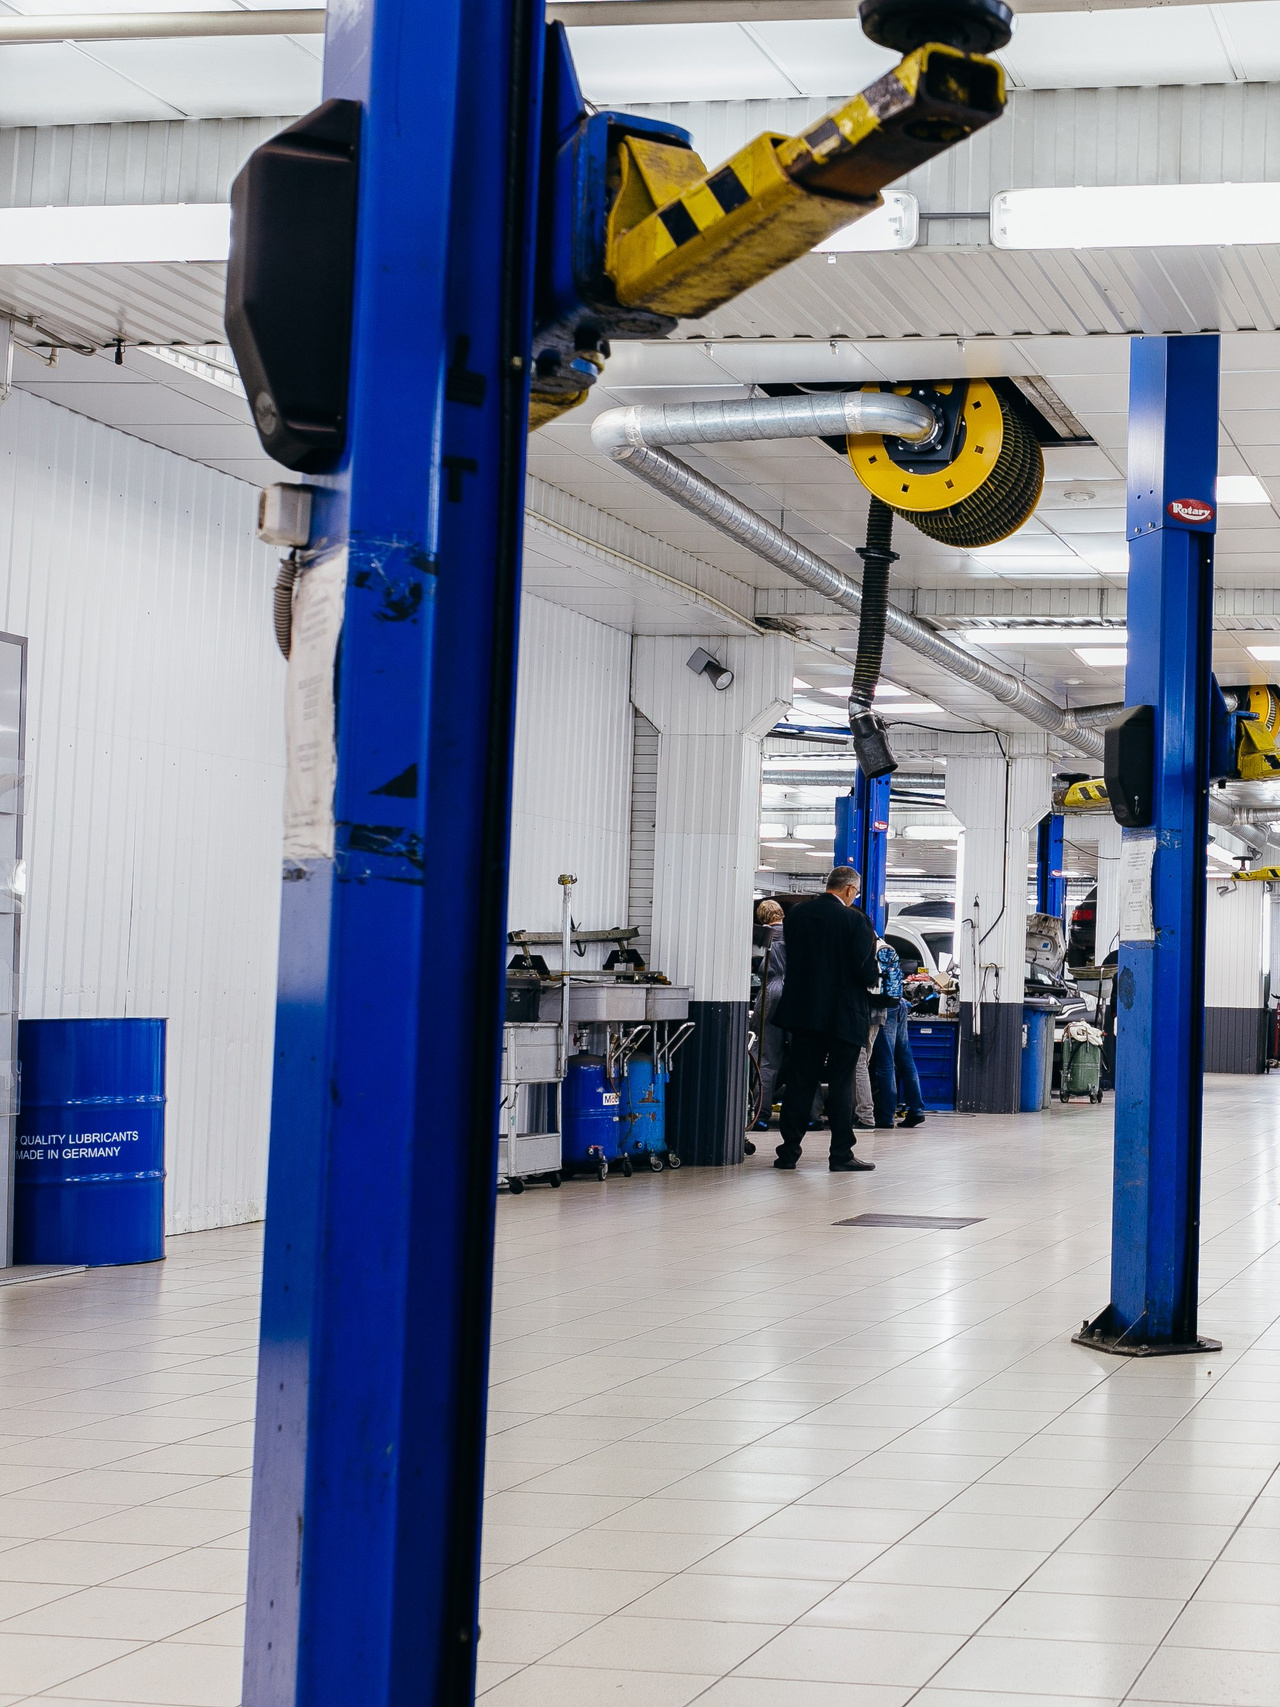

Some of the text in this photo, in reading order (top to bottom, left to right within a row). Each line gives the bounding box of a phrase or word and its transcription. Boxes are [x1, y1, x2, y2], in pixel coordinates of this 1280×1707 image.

[1172, 502, 1211, 521] Rotary
[20, 1134, 66, 1146] QUALITY
[68, 1130, 139, 1145] LUBRICANTS
[16, 1146, 121, 1160] MADE IN GERMANY
